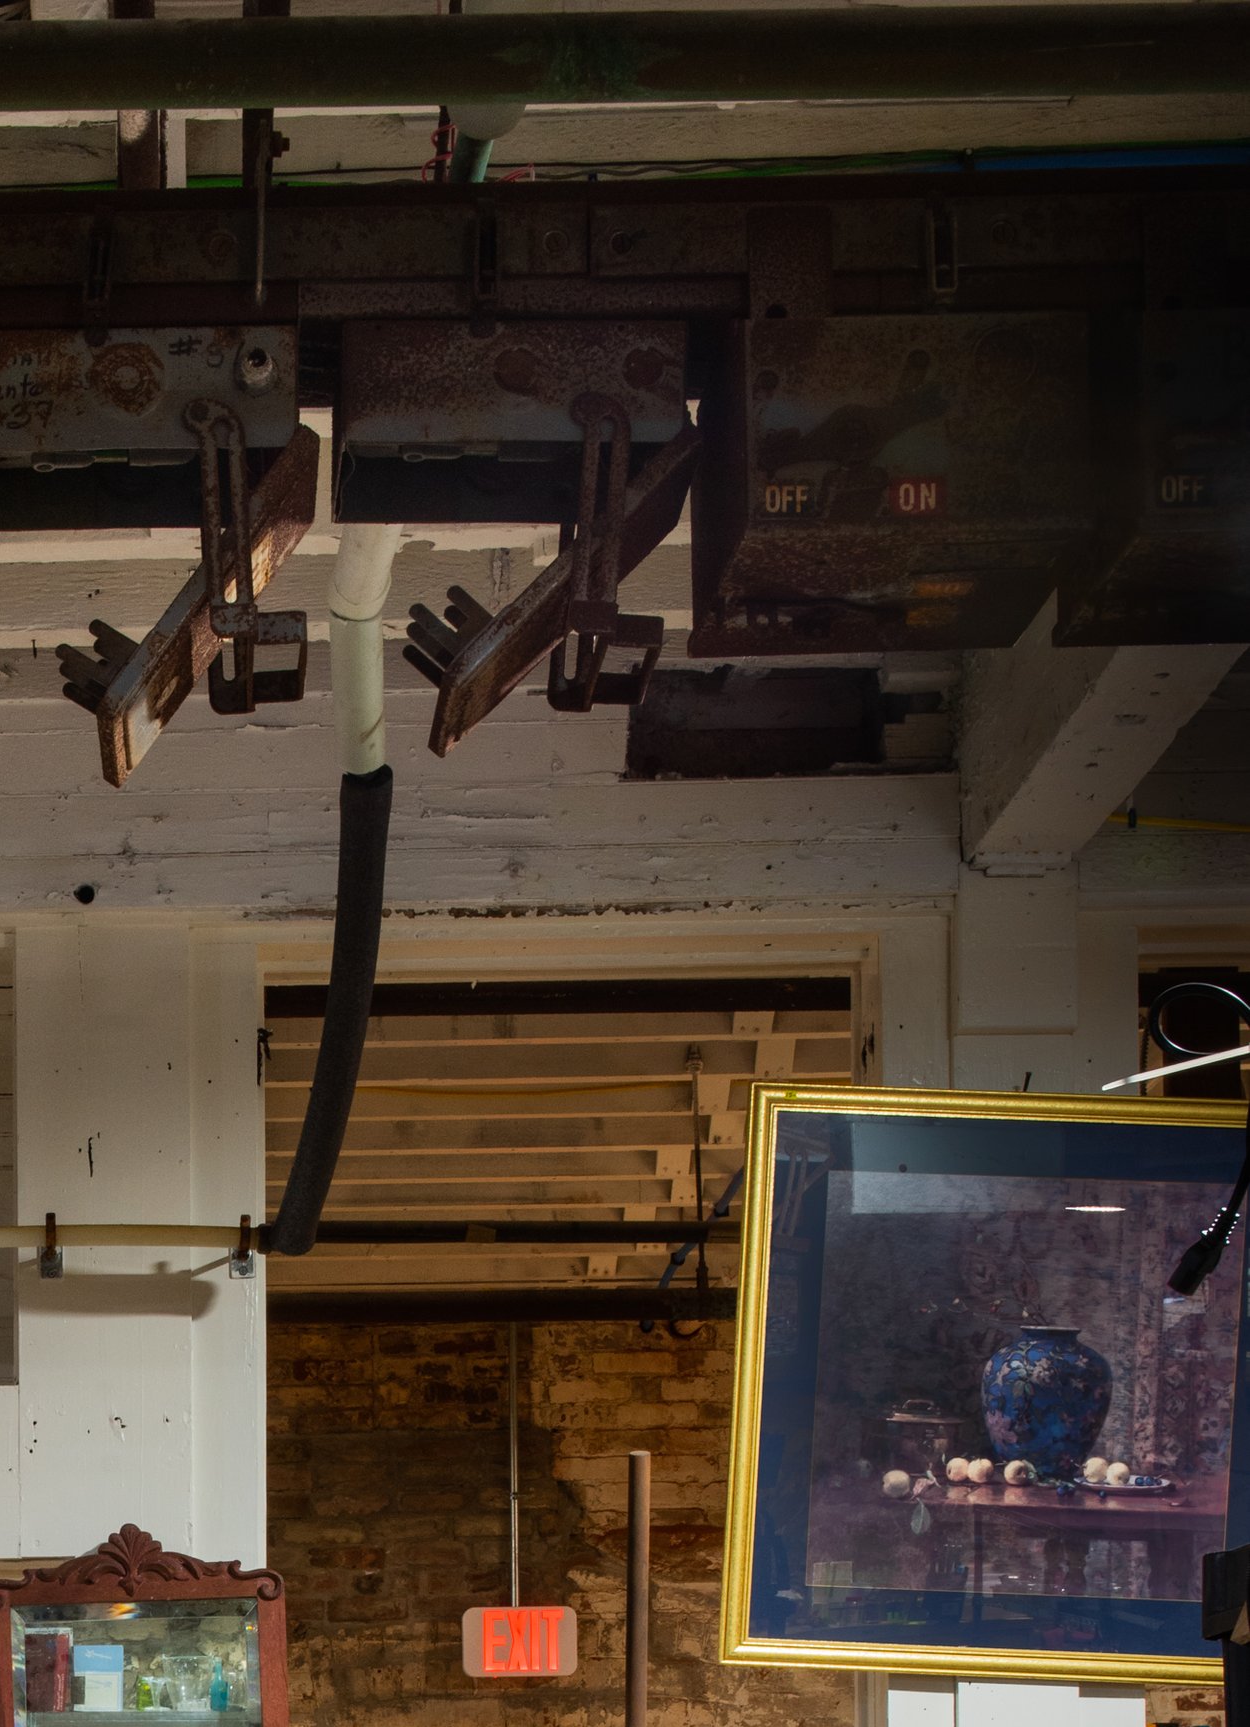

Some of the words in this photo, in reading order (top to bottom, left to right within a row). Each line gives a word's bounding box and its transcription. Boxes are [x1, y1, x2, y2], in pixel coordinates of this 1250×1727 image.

[764, 485, 808, 514] OFF
[898, 482, 937, 513] ON
[1161, 475, 1206, 504] OFF
[482, 1609, 564, 1672] EXIT
